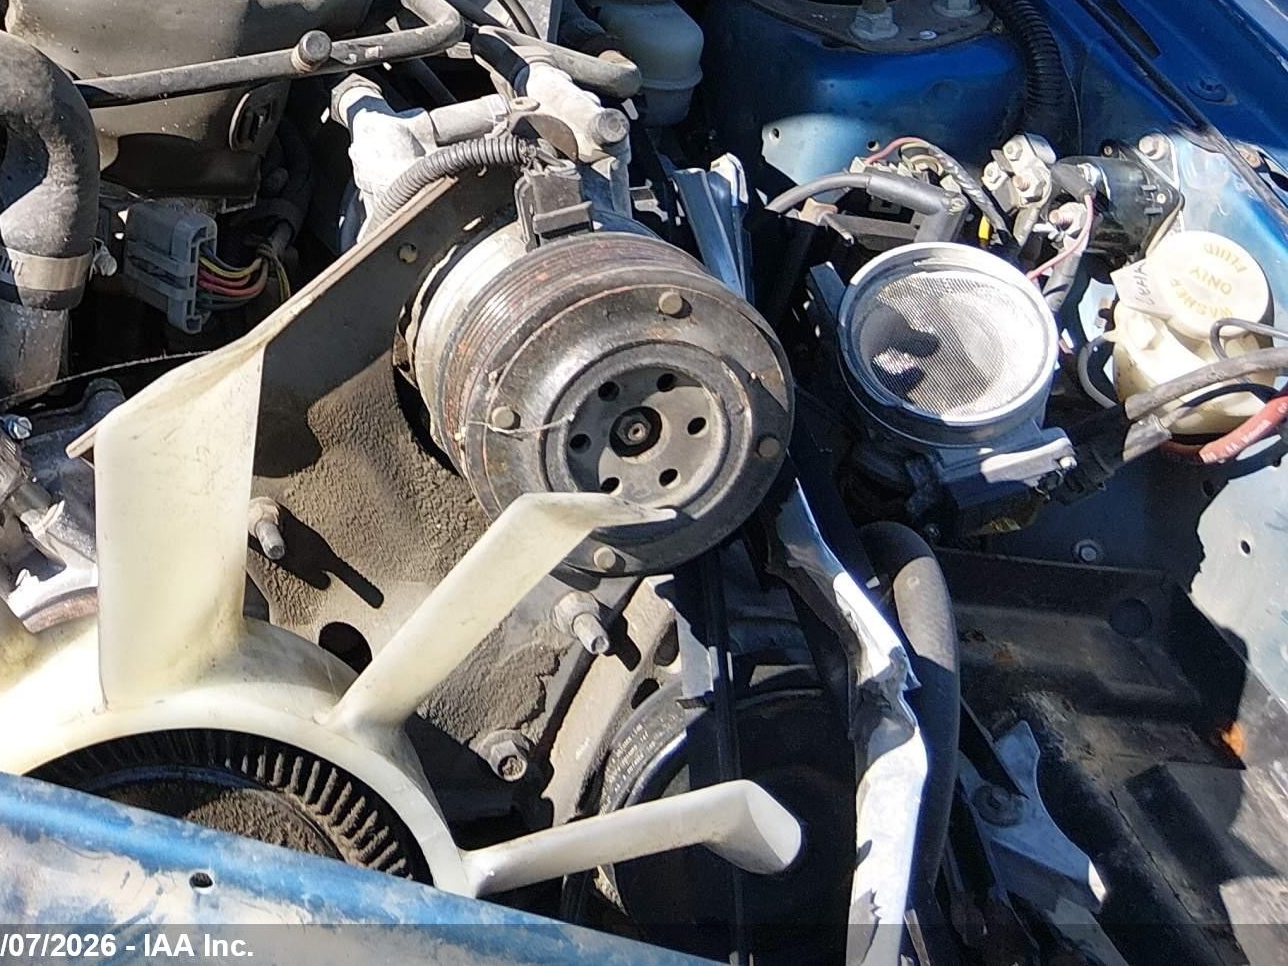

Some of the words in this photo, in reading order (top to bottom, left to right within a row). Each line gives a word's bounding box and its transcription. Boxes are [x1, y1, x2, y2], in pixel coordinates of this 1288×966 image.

[1203, 243, 1248, 273] FLUID
[1189, 266, 1233, 295] ONLY
[1170, 278, 1233, 319] WASHER
